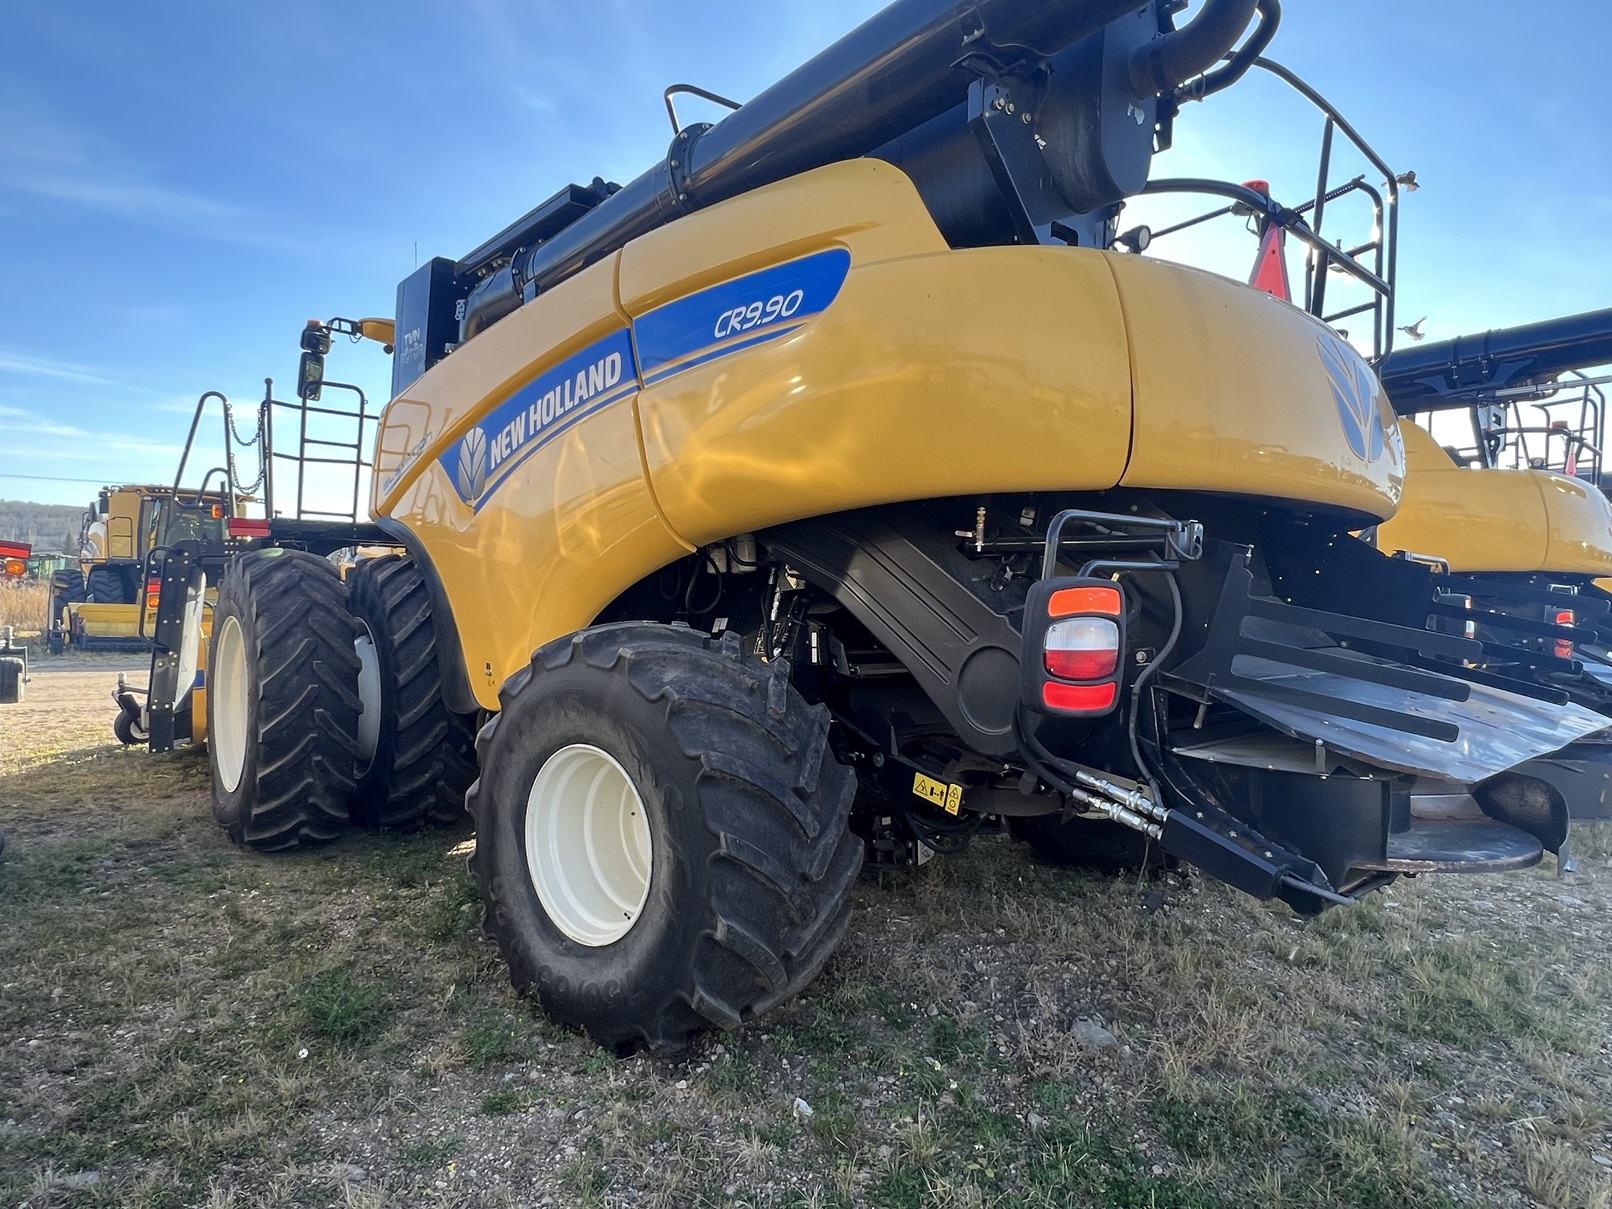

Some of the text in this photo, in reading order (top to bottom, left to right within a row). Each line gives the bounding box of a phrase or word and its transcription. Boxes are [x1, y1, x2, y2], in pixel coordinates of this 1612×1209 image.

[714, 289, 804, 338] CR9.90
[490, 352, 622, 470] NEW HOLLAND
